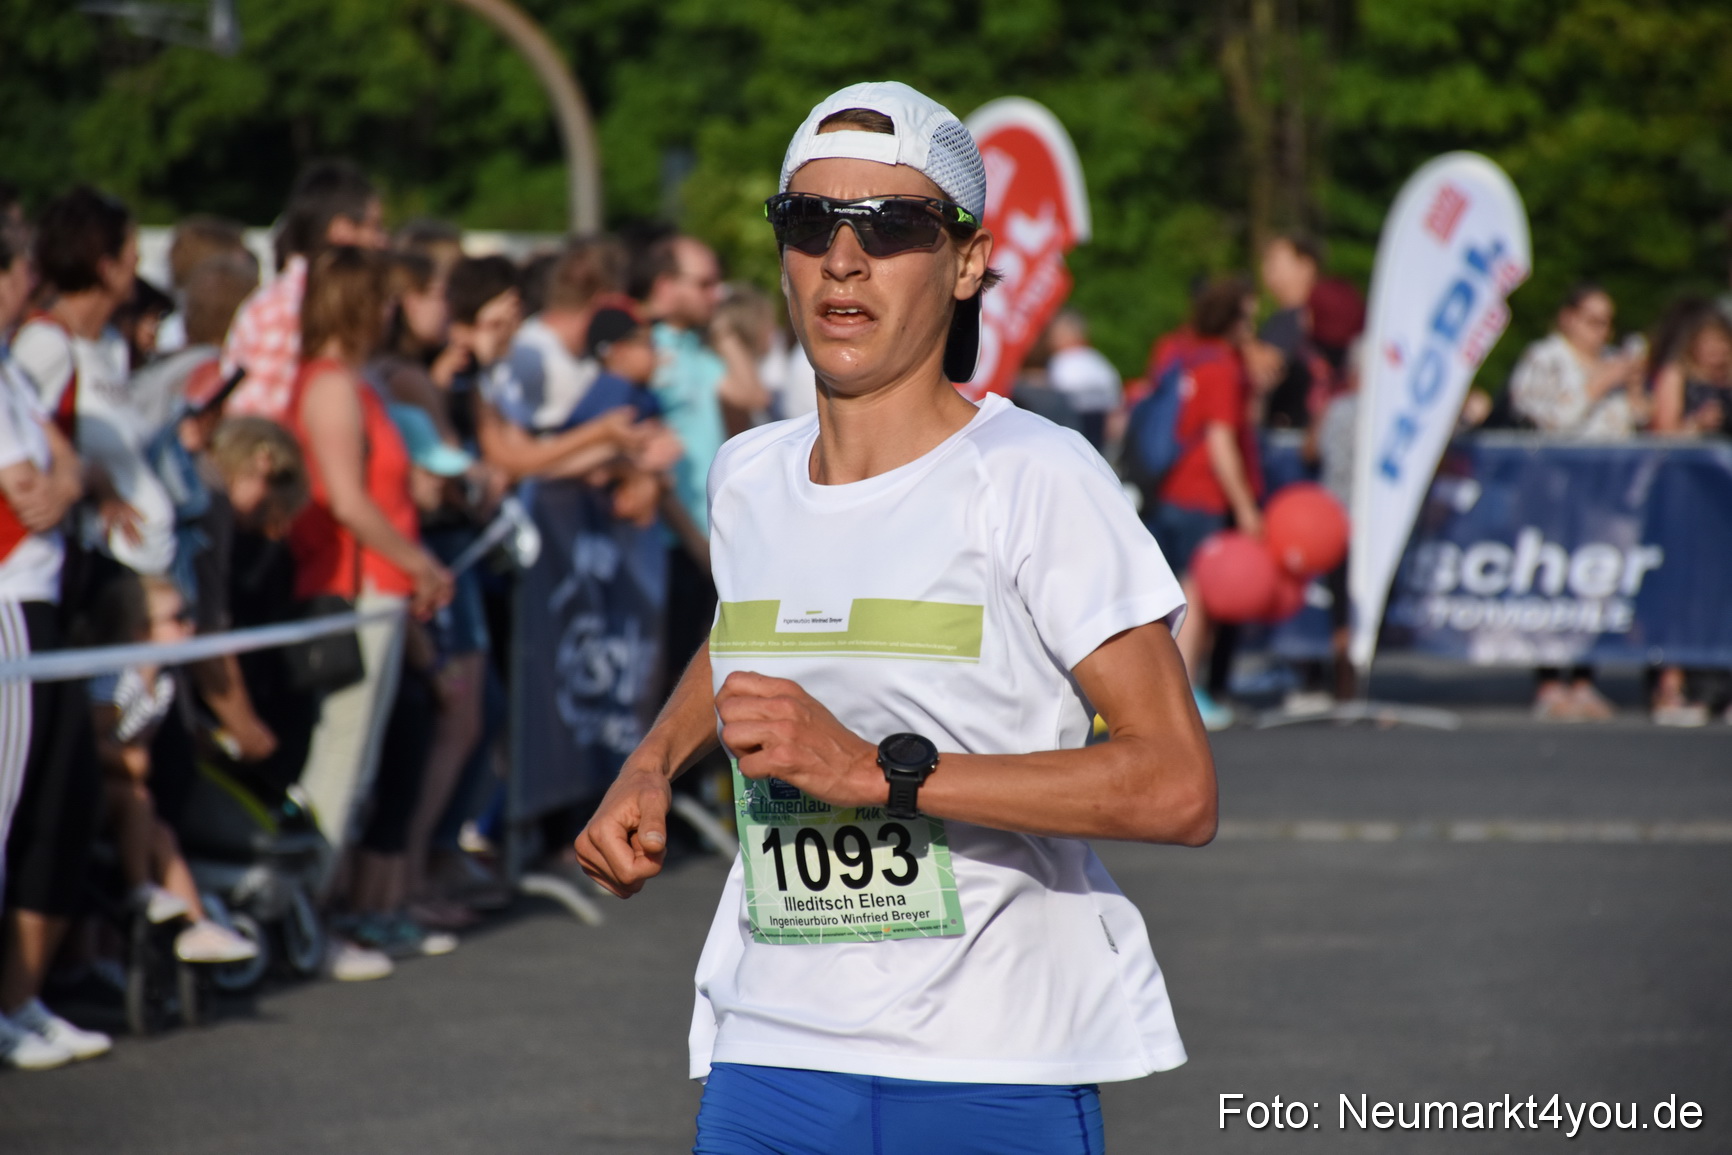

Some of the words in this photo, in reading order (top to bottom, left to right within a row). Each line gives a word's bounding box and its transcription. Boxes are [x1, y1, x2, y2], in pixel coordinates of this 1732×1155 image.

[762, 822, 919, 892] 1093
[784, 893, 854, 912] Illeditsch
[858, 892, 907, 909] Elena
[769, 915, 838, 929] Ingenieurbüro
[841, 911, 889, 925] Winfried
[892, 909, 931, 923] Breyer
